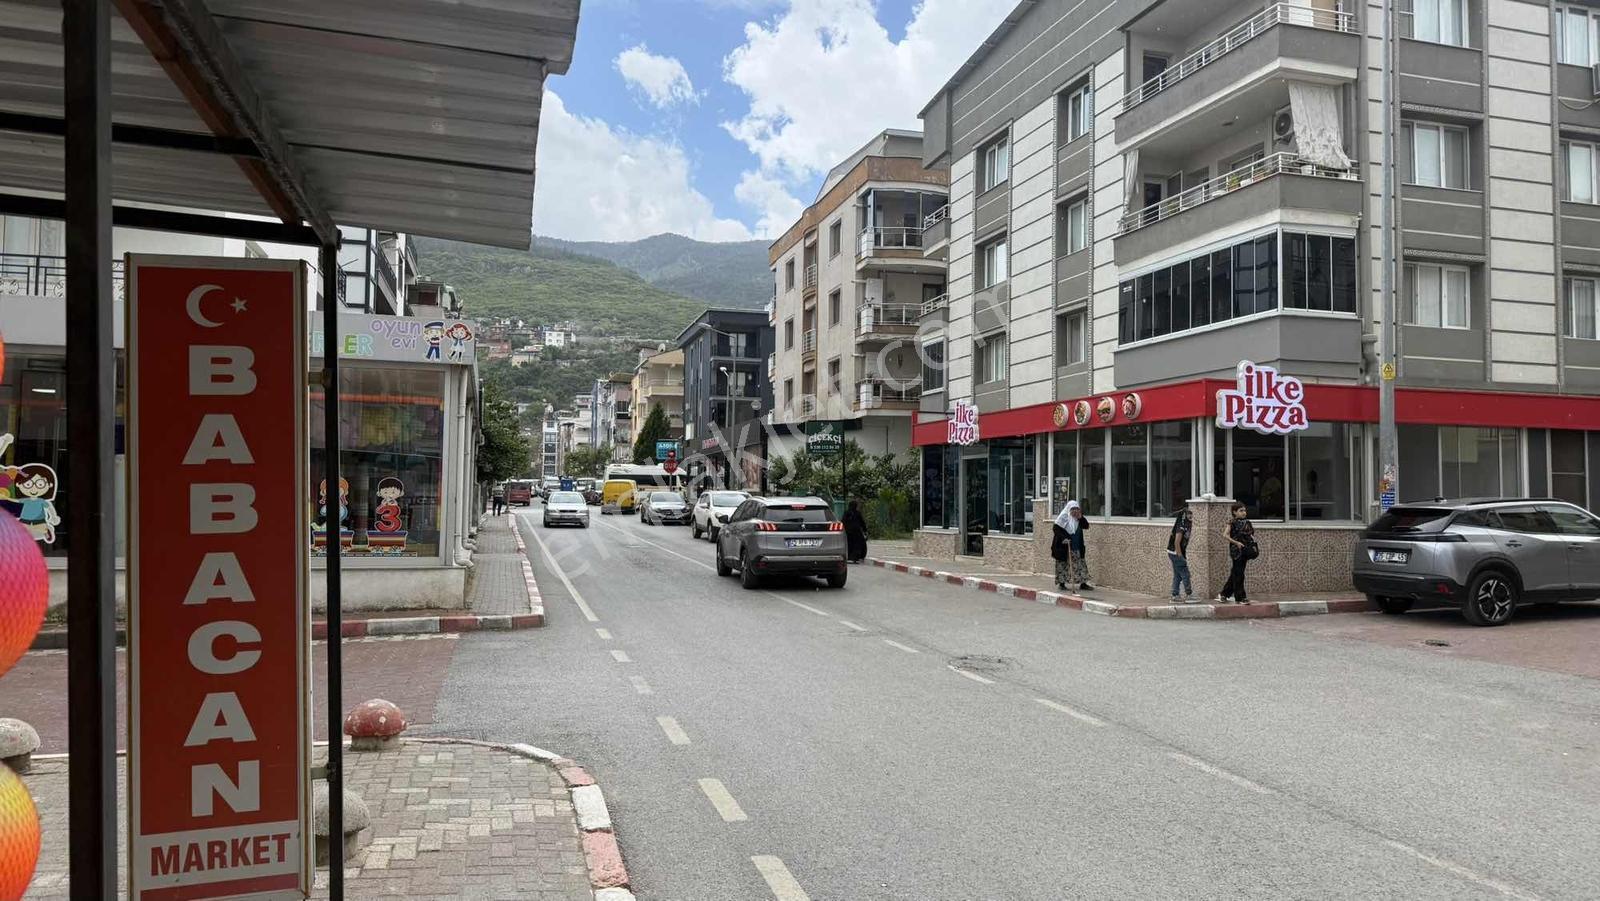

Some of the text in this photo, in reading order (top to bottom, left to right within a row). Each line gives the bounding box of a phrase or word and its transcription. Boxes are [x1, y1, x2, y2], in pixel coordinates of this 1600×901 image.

[369, 318, 423, 339] oyun
[391, 335, 418, 350] evi
[1225, 394, 1305, 429] Pizza
[949, 421, 974, 444] Pizza
[664, 462, 678, 471] DUR
[373, 503, 403, 532] 3
[182, 344, 264, 818] BABACAN
[150, 832, 291, 877] MARKET
